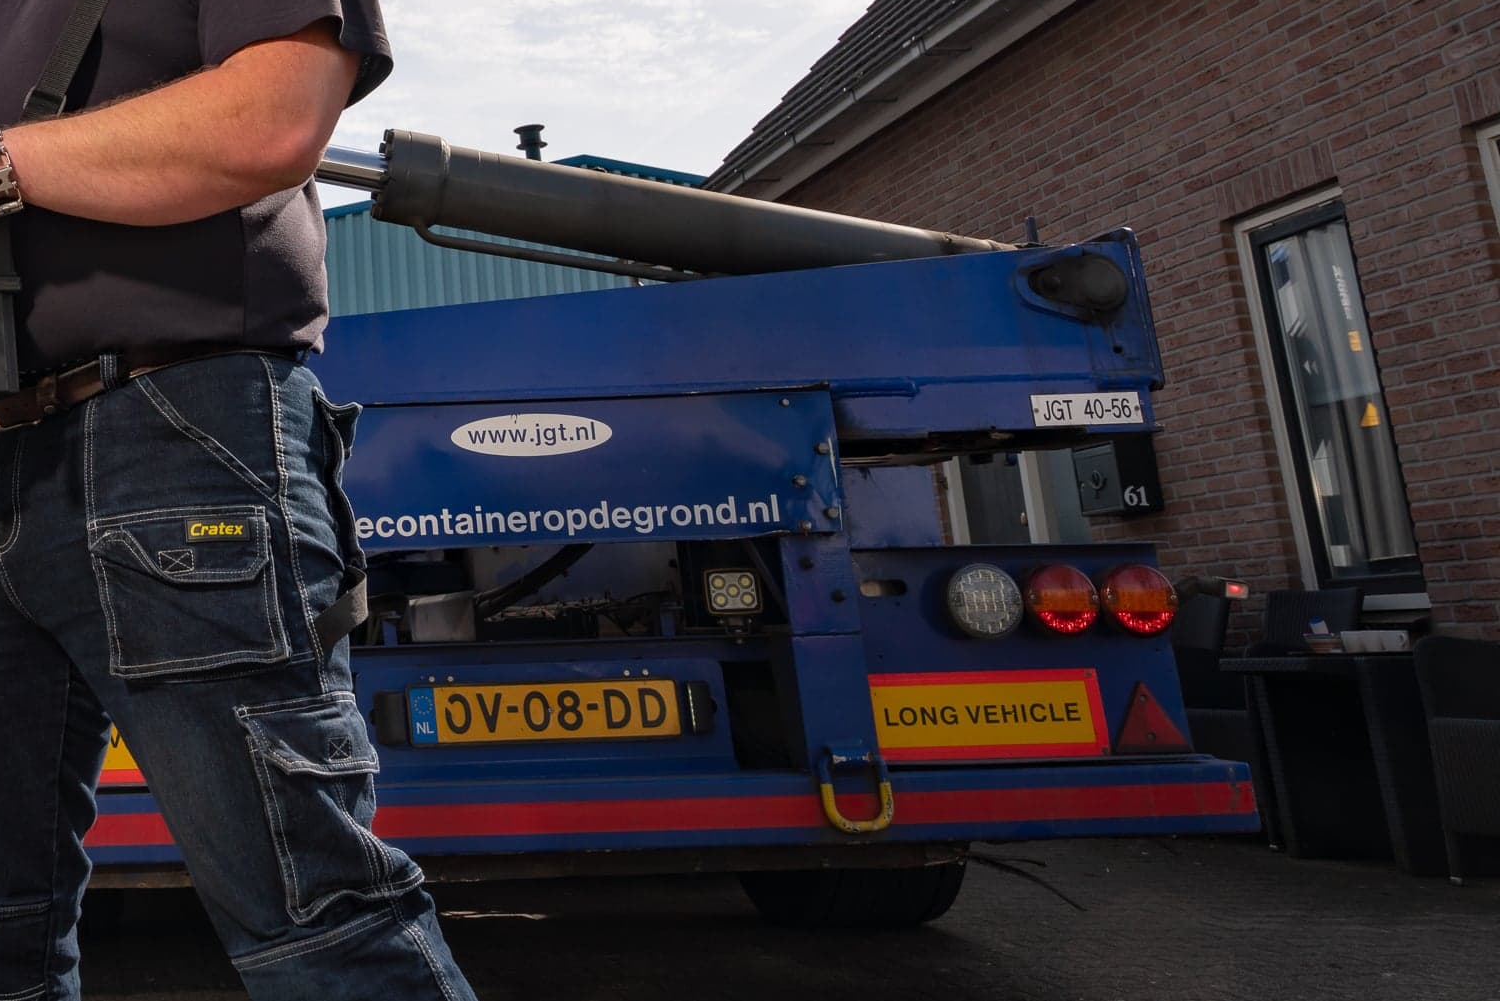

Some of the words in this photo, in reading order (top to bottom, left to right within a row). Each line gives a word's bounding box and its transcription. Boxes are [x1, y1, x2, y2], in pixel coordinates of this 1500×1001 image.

[1043, 399, 1073, 421] JGT
[1084, 398, 1132, 419] 40-56
[468, 421, 596, 446] www.jgt.nl
[1124, 485, 1150, 507] 61
[190, 521, 244, 537] Cratex
[445, 687, 667, 735] OV-08-DD
[884, 705, 959, 727] LONG
[965, 702, 1082, 725] VEHICLE
[416, 721, 435, 735] NL
